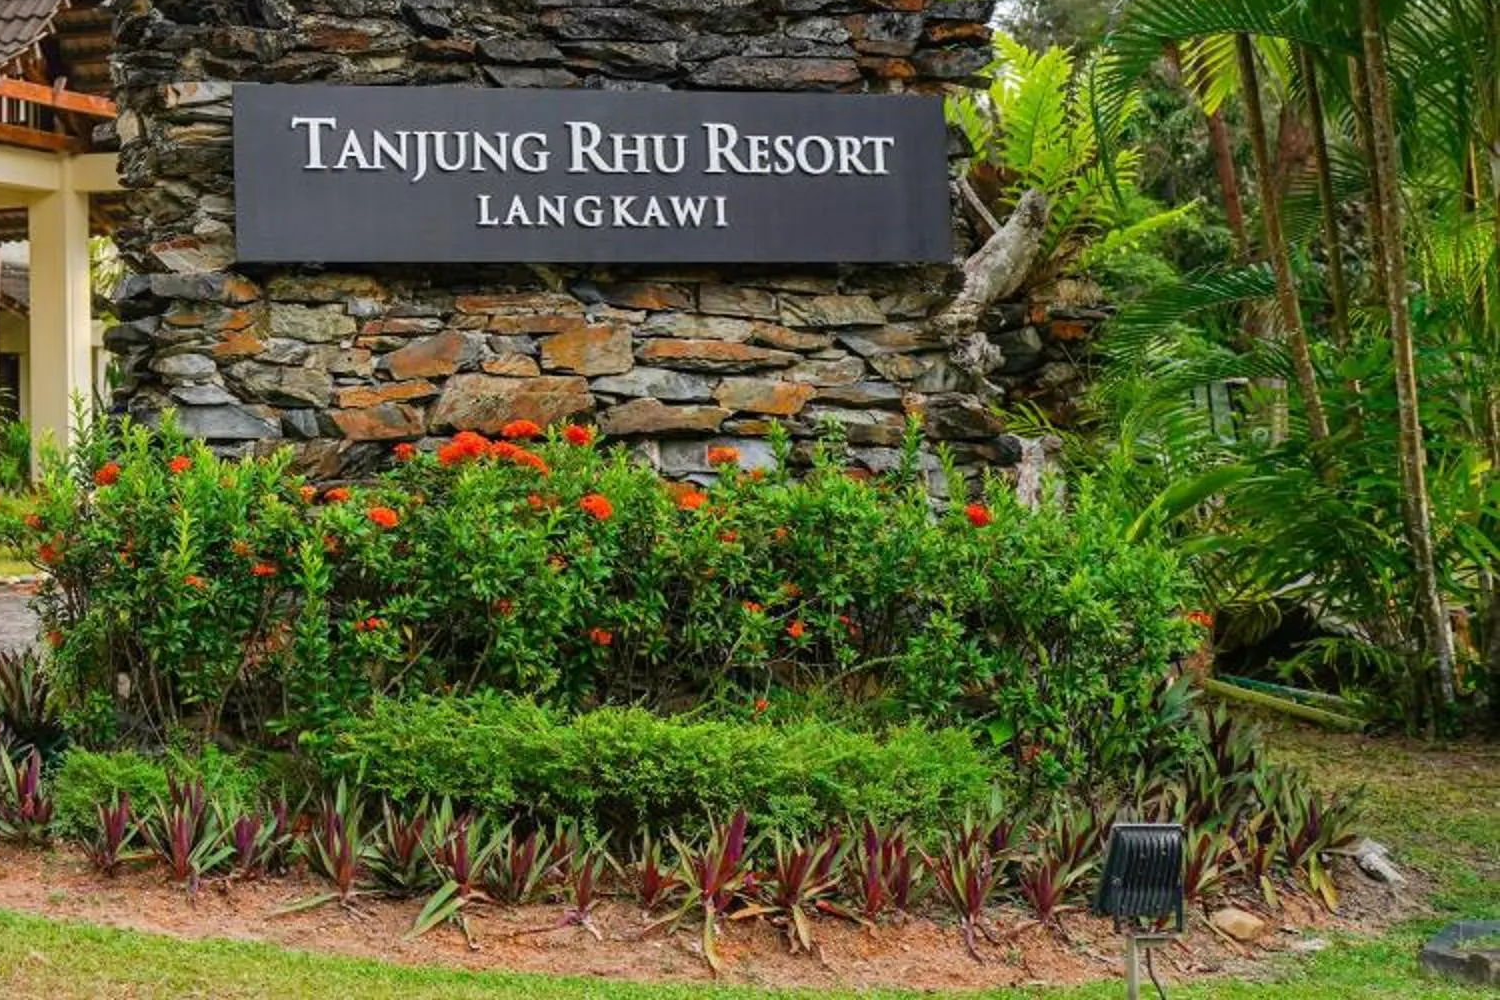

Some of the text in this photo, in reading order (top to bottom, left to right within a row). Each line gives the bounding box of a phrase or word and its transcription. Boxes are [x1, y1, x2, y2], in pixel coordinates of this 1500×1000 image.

[290, 115, 895, 183] TANJUNG RHU RESORT
[476, 193, 729, 228] LANGKAWI
